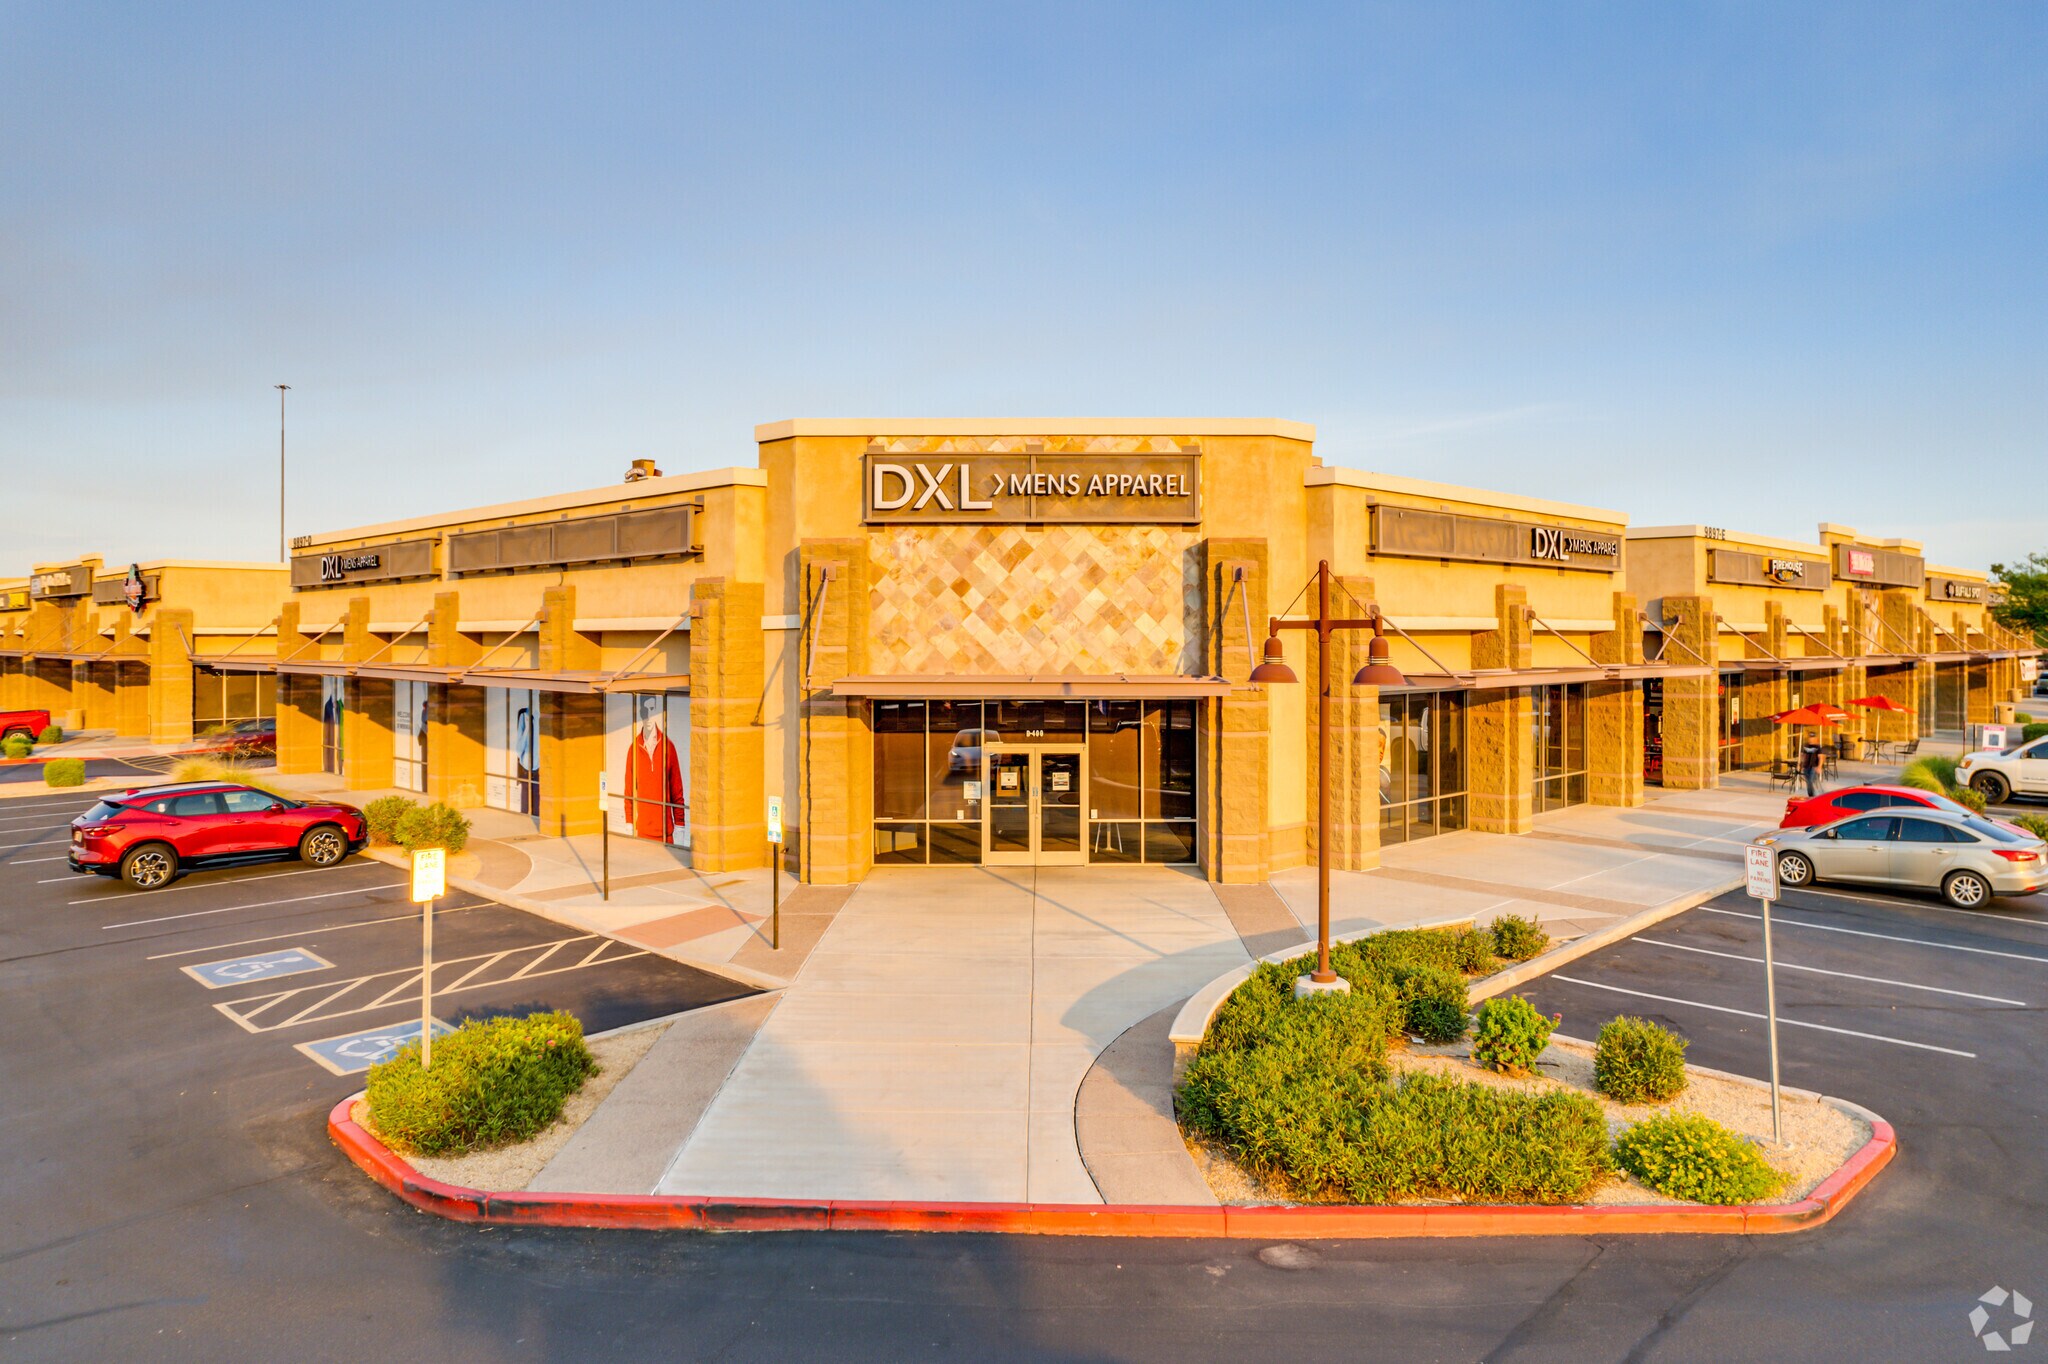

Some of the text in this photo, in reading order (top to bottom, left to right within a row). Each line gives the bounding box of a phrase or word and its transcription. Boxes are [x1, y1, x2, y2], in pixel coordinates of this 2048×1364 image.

[873, 463, 1191, 510] DXL MENS APPAREL
[1704, 526, 1726, 541] 9897-E
[1535, 527, 1619, 561] DXL MENS APPAREL
[321, 554, 377, 580] DXL MENS APPAREL
[1772, 559, 1803, 577] FIREHOUSE
[1751, 850, 1767, 858] FIRE
[1751, 859, 1769, 867] LANE
